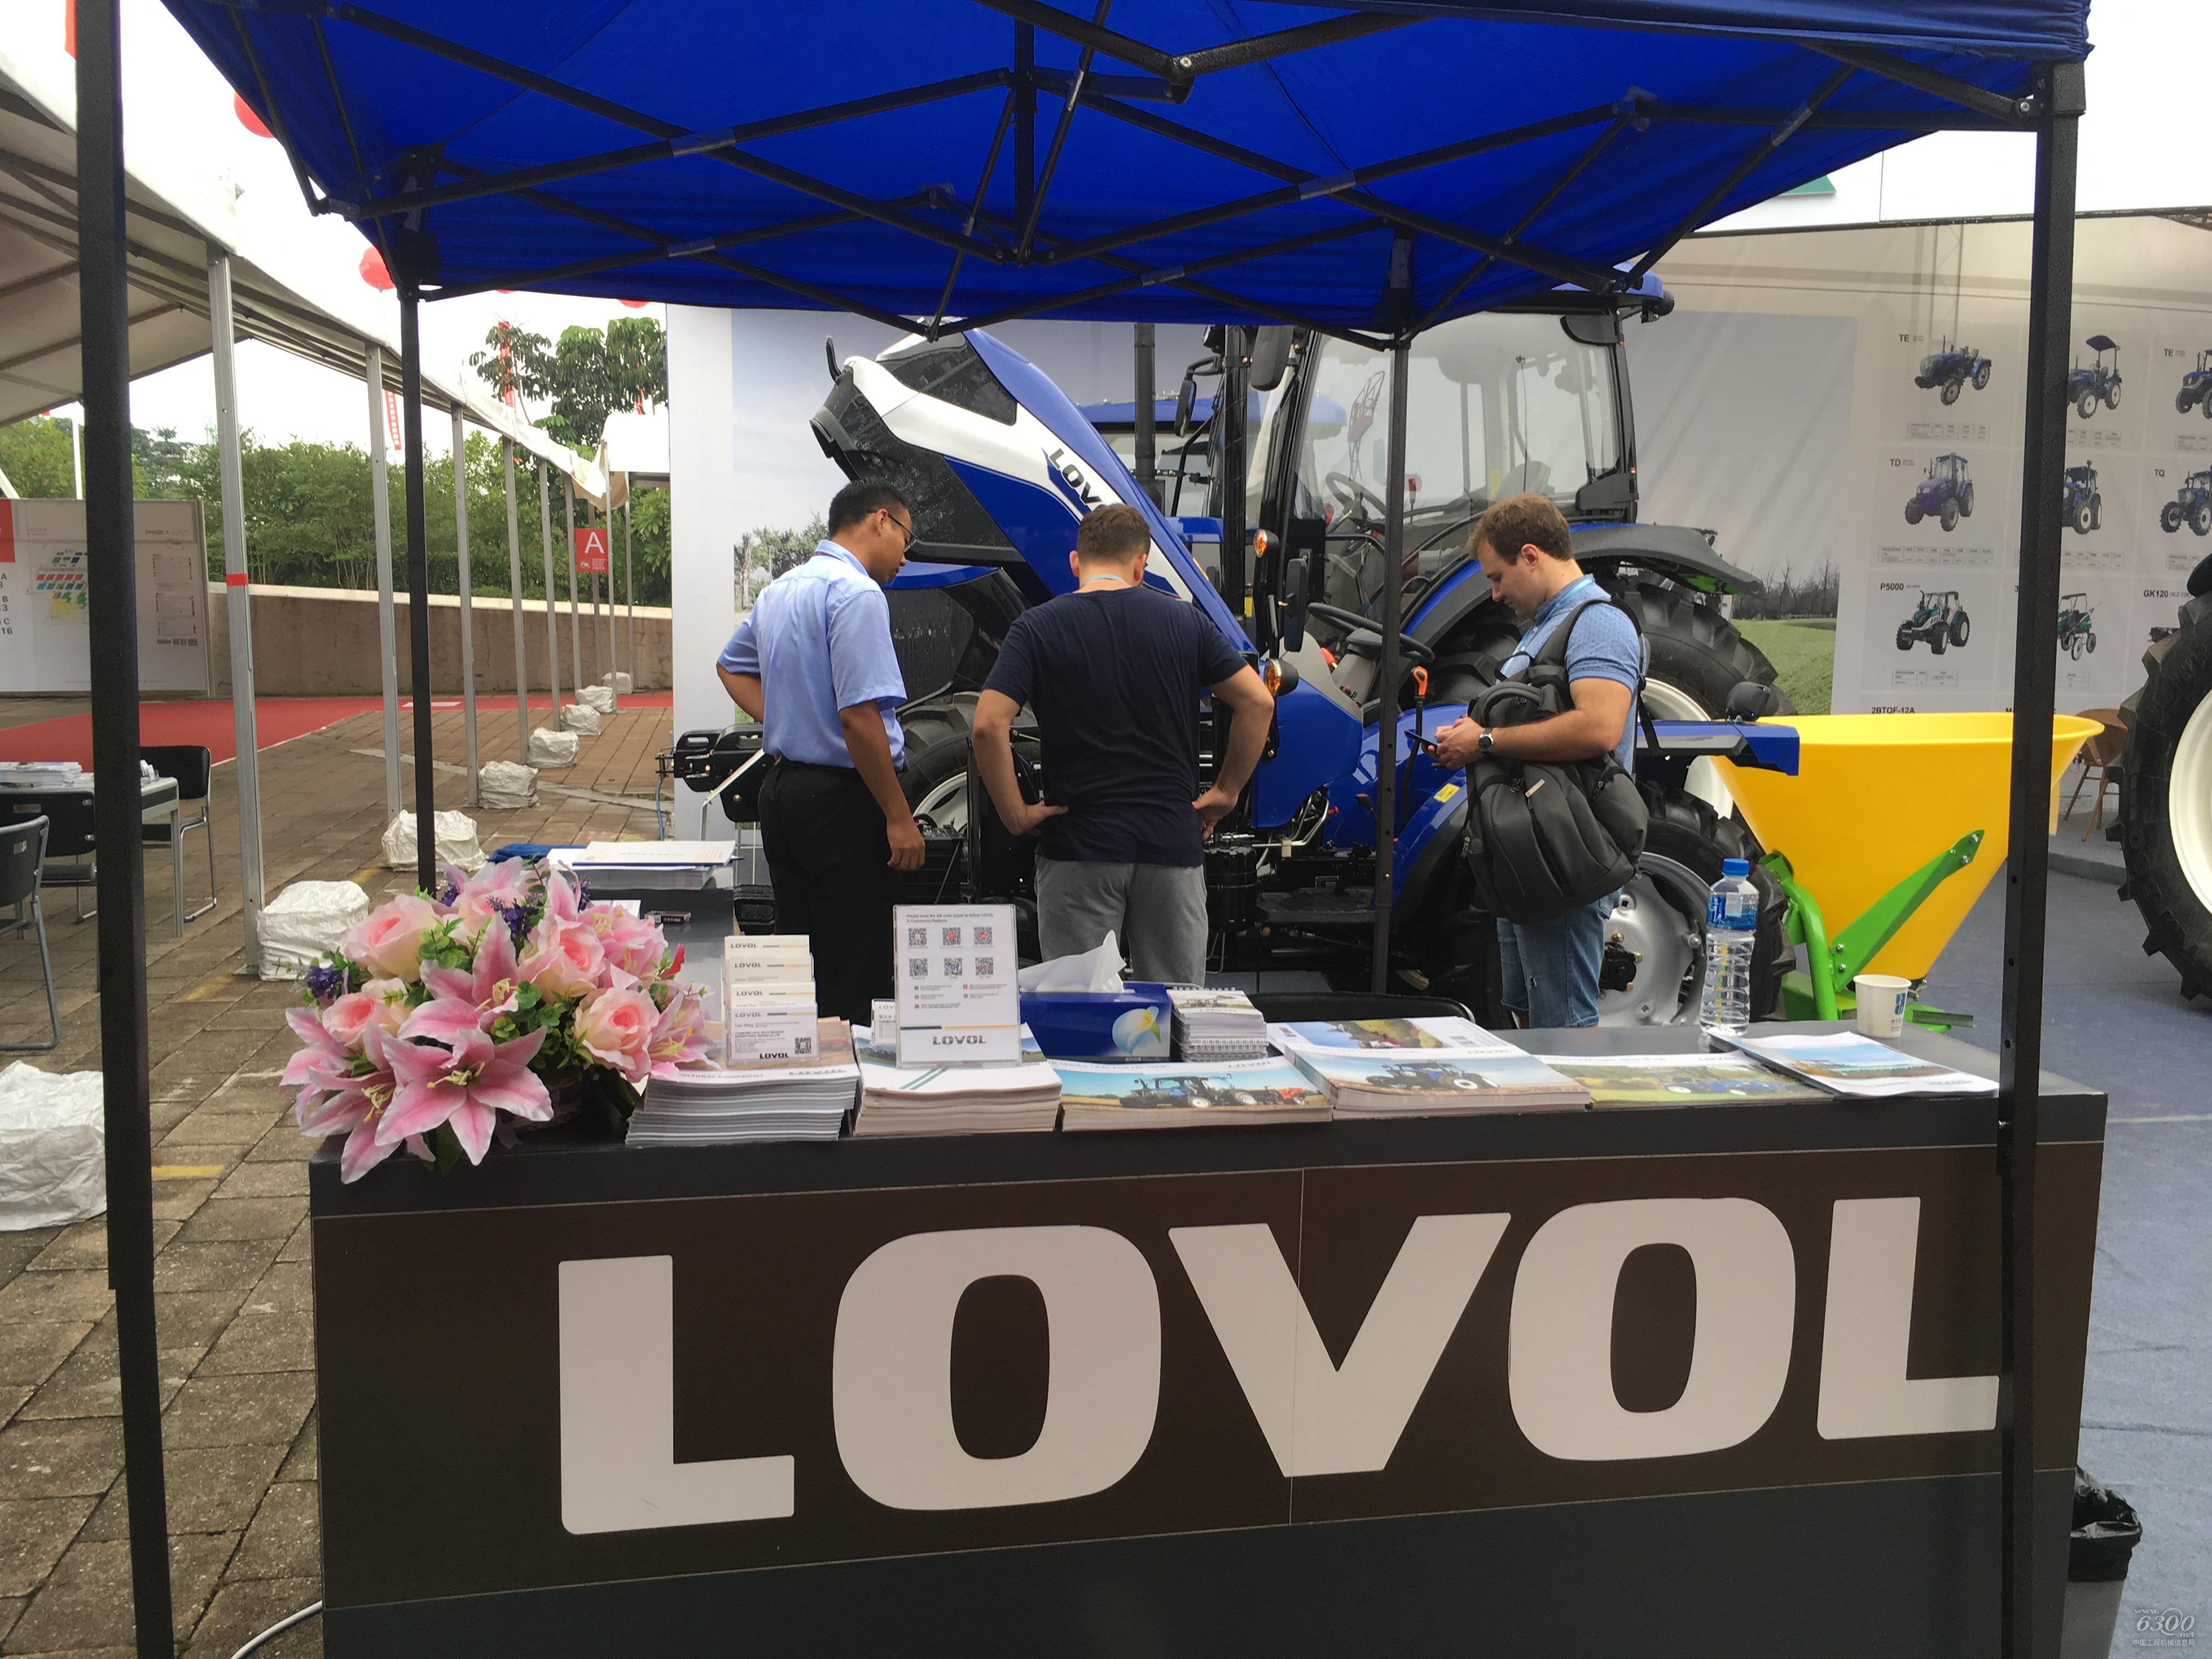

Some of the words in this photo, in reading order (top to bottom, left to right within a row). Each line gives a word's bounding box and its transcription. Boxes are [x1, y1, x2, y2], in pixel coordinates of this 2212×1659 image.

[1899, 334, 1909, 342] TE
[2164, 348, 2173, 357] TE
[1049, 448, 1102, 504] LOV
[585, 532, 605, 554] A
[2143, 589, 2168, 597] GK120
[933, 1035, 986, 1045] LOVOL
[558, 1197, 2000, 1534] LOVOL
